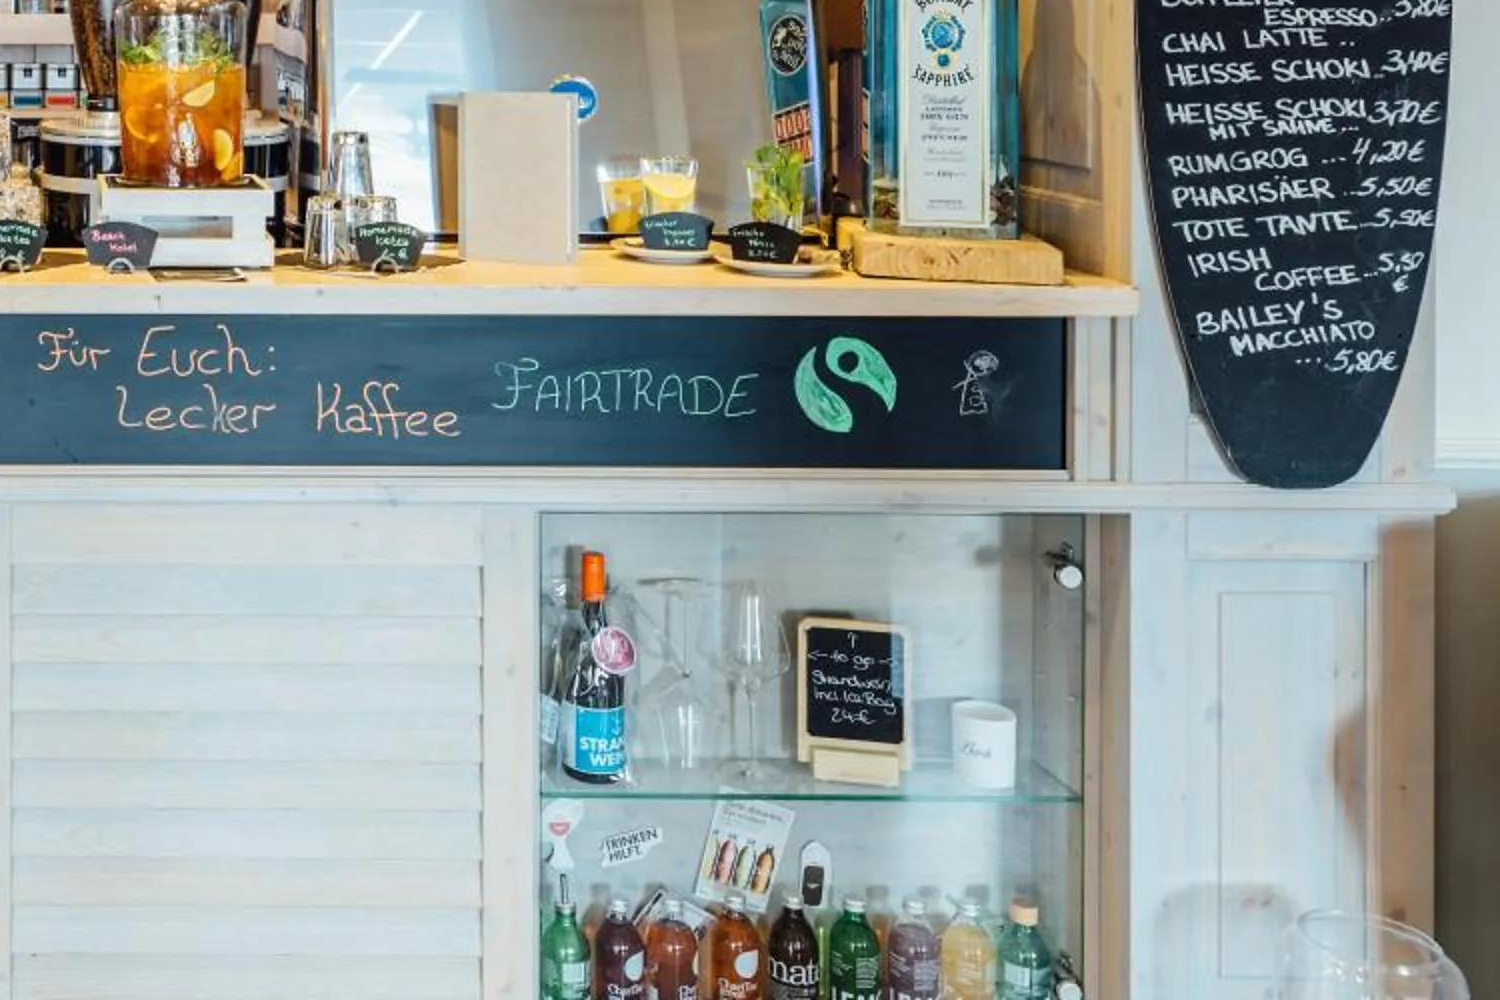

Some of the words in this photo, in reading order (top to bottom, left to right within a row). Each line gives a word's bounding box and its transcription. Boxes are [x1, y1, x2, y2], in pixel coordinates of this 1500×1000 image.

[1264, 7, 1379, 27] ESPRESSO
[1162, 31, 1226, 53] CHAI
[1243, 27, 1330, 49] LATTE
[912, 64, 976, 87] SAPPHIRE
[1165, 62, 1262, 87] HEISSE
[1271, 58, 1371, 83] SCHOKI
[1165, 102, 1264, 125] HEISSE
[1275, 98, 1367, 119] SCHOKI
[1208, 122, 1252, 140] MIT
[1262, 119, 1337, 137] SAHNE
[1168, 148, 1308, 177] RUMGROG
[1172, 175, 1335, 209] PHARISÄER
[1173, 216, 1250, 242] TOTE
[1256, 210, 1359, 238] TANTE
[1187, 248, 1273, 278] IRISH
[1255, 265, 1361, 291] COFFEE
[1196, 292, 1344, 336] BAILEY'S
[36, 327, 111, 372] Für
[136, 323, 278, 378] Euch:
[1229, 321, 1376, 356] MACCHIATO
[491, 358, 760, 417] FAIRTRADE
[116, 383, 277, 434] Lecker
[315, 380, 462, 439] Kaffee
